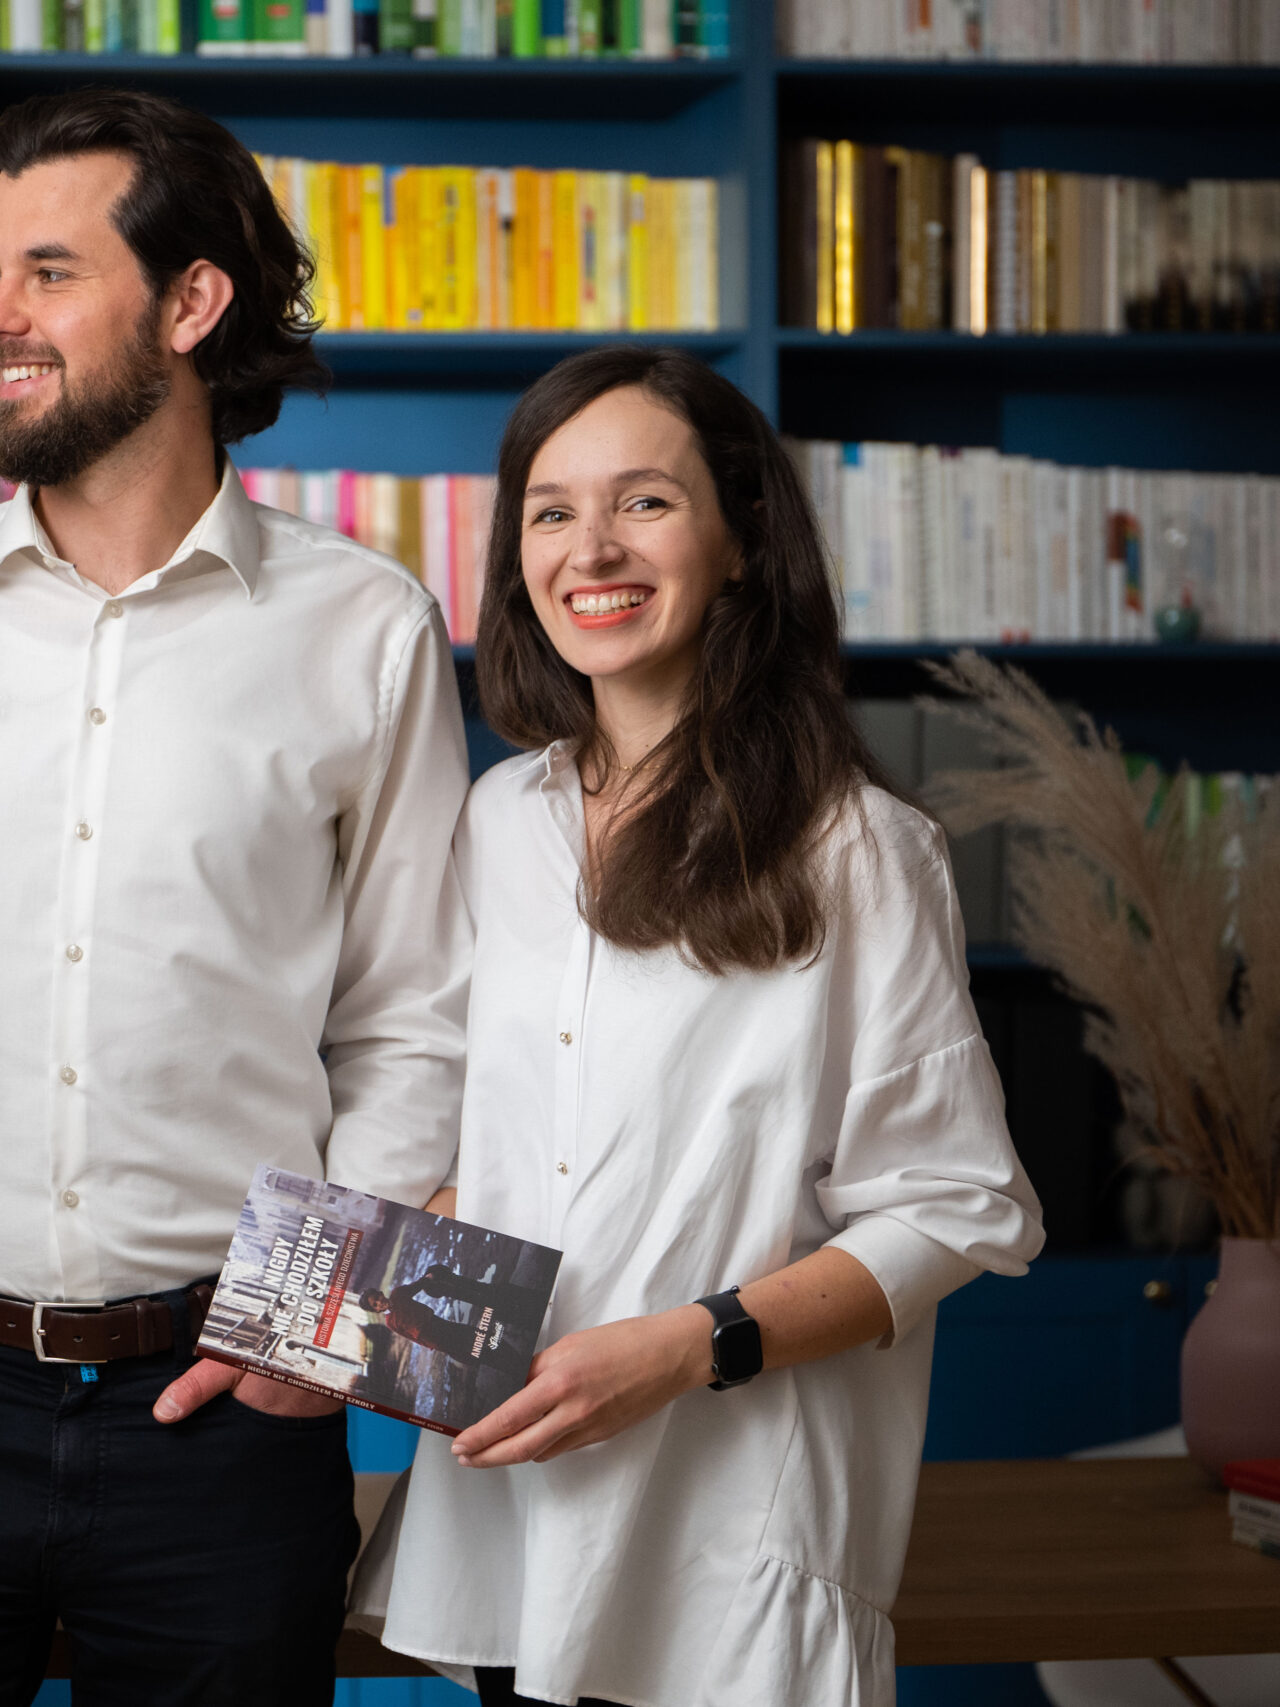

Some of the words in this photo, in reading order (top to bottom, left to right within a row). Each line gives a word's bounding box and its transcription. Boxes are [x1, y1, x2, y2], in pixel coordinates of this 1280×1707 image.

[263, 1236, 294, 1288] NIGDY
[281, 1216, 325, 1307] CHODZIŁEM
[306, 1238, 339, 1299] SZKOŁY
[317, 1317, 332, 1345] HISTORIA
[326, 1269, 347, 1317] SZCZĘŚLIWEGO
[340, 1232, 360, 1273] DZIECIŃSTWA
[270, 1308, 294, 1336] NIE
[297, 1301, 319, 1327] DO
[478, 1306, 494, 1332] STERN
[471, 1330, 486, 1359] ANDRÉ
[248, 1365, 272, 1377] NIGDY
[273, 1372, 287, 1382] NIE
[333, 1391, 345, 1401] DO
[346, 1395, 376, 1411] SZKOŁY
